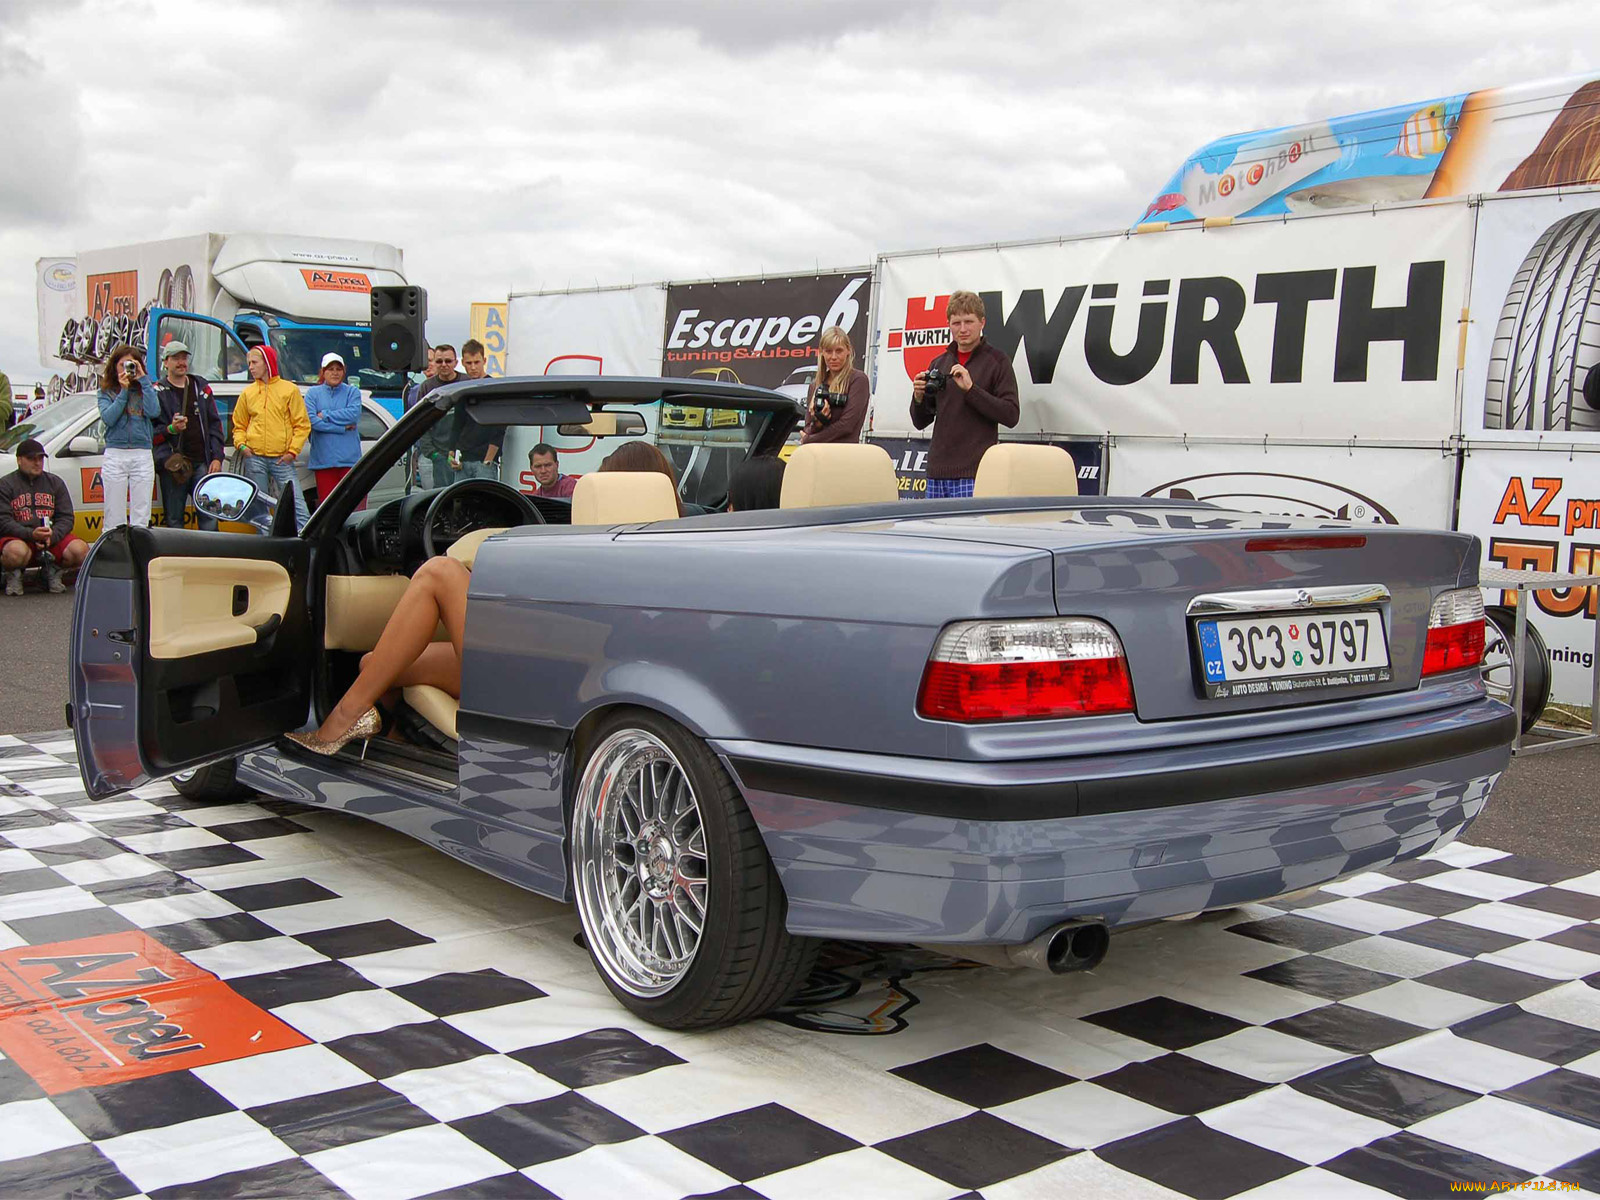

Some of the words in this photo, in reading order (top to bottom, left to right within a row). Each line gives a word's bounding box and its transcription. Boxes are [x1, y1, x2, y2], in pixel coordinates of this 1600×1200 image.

[311, 271, 337, 283] AZ
[338, 276, 366, 286] pneu
[904, 328, 951, 346] WÜRTH
[978, 260, 1445, 386] WÜRTH
[1493, 476, 1563, 526] AZ
[1228, 625, 1286, 673] 3C3
[1306, 618, 1369, 666] 9797
[1546, 646, 1593, 668] ning
[1207, 660, 1223, 675] CZ
[1232, 683, 1248, 696] AUTO
[1247, 681, 1269, 694] DESIGN
[1271, 680, 1293, 692] TUNING
[18, 951, 176, 999] AZ
[58, 994, 206, 1061] pneu
